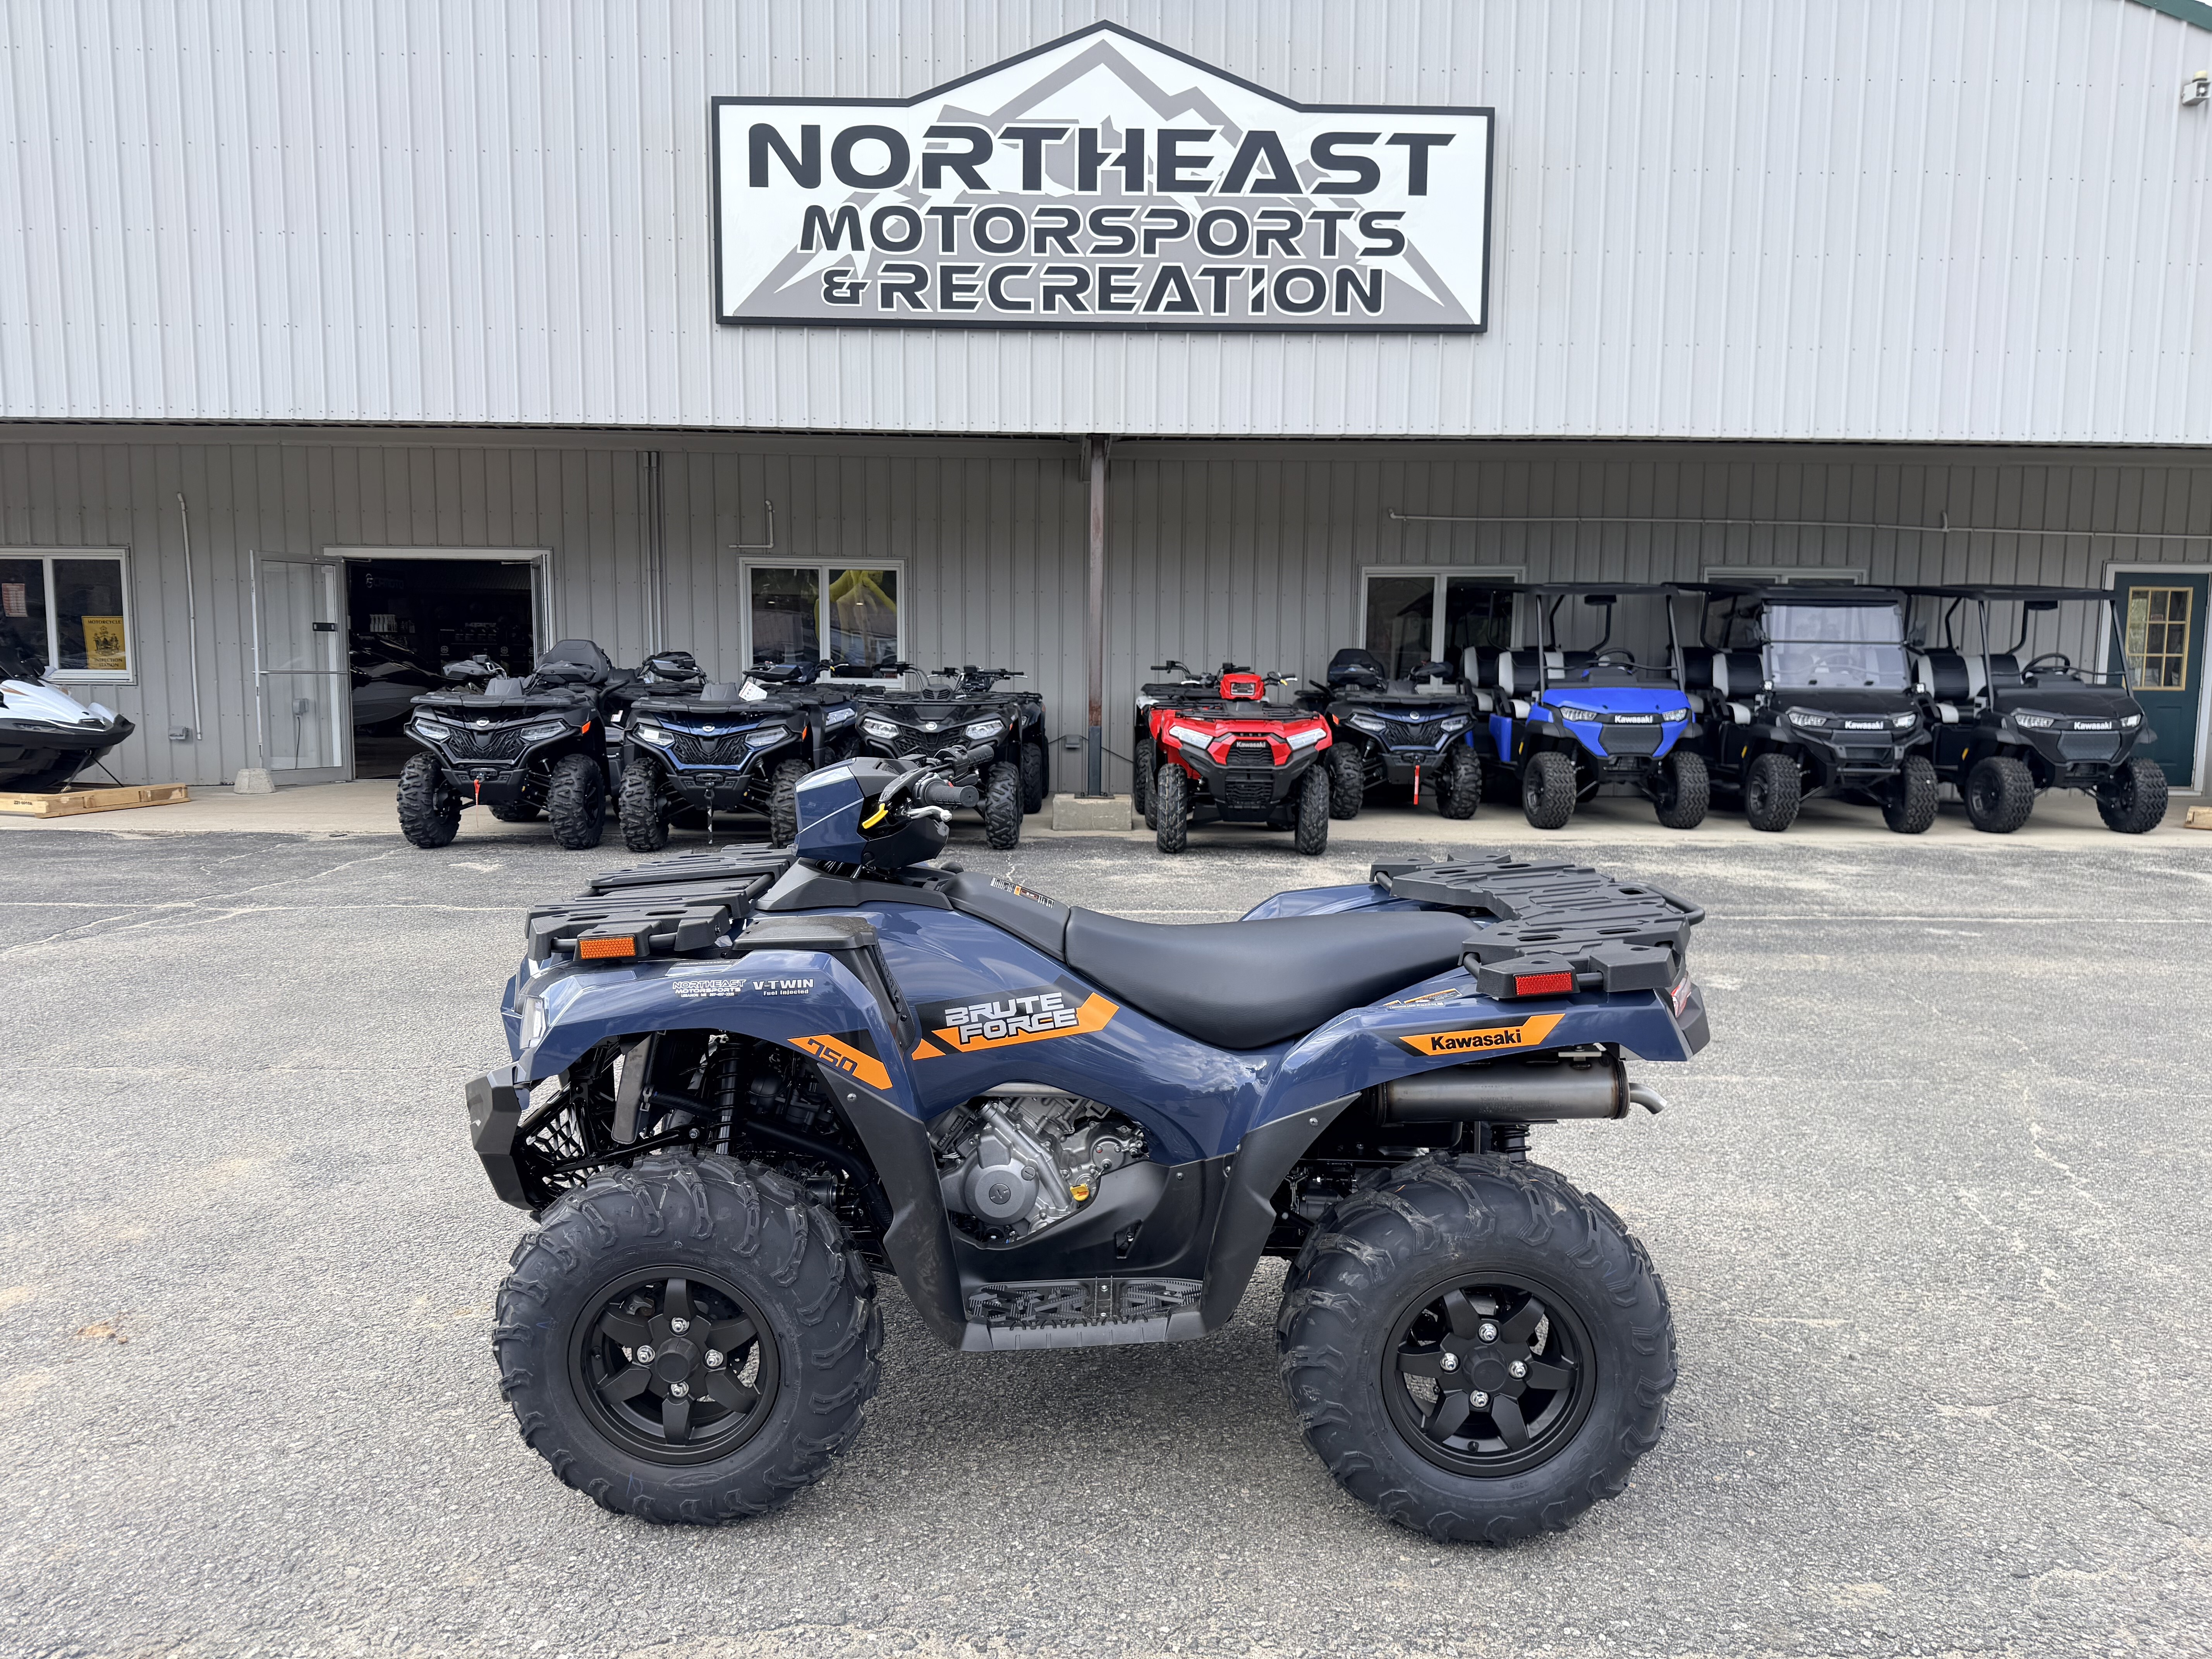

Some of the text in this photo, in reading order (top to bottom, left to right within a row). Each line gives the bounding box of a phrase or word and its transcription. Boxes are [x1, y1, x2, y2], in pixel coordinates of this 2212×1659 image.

[748, 123, 1457, 196] NORTHEAST
[800, 205, 1405, 257] MOTORSPORTS
[823, 263, 1384, 313] & RECREATION
[1614, 715, 1653, 723] Kawasaki
[1845, 721, 1884, 729] Kawasaki
[2074, 721, 2112, 730] Kawasaki
[673, 979, 747, 989] NORTHEAST
[753, 979, 814, 990] V-TWIN
[945, 992, 1063, 1027] BRUTE
[960, 1008, 1078, 1043] FORCE
[1431, 1029, 1522, 1050] Kawasaki
[807, 1038, 857, 1074] 750
